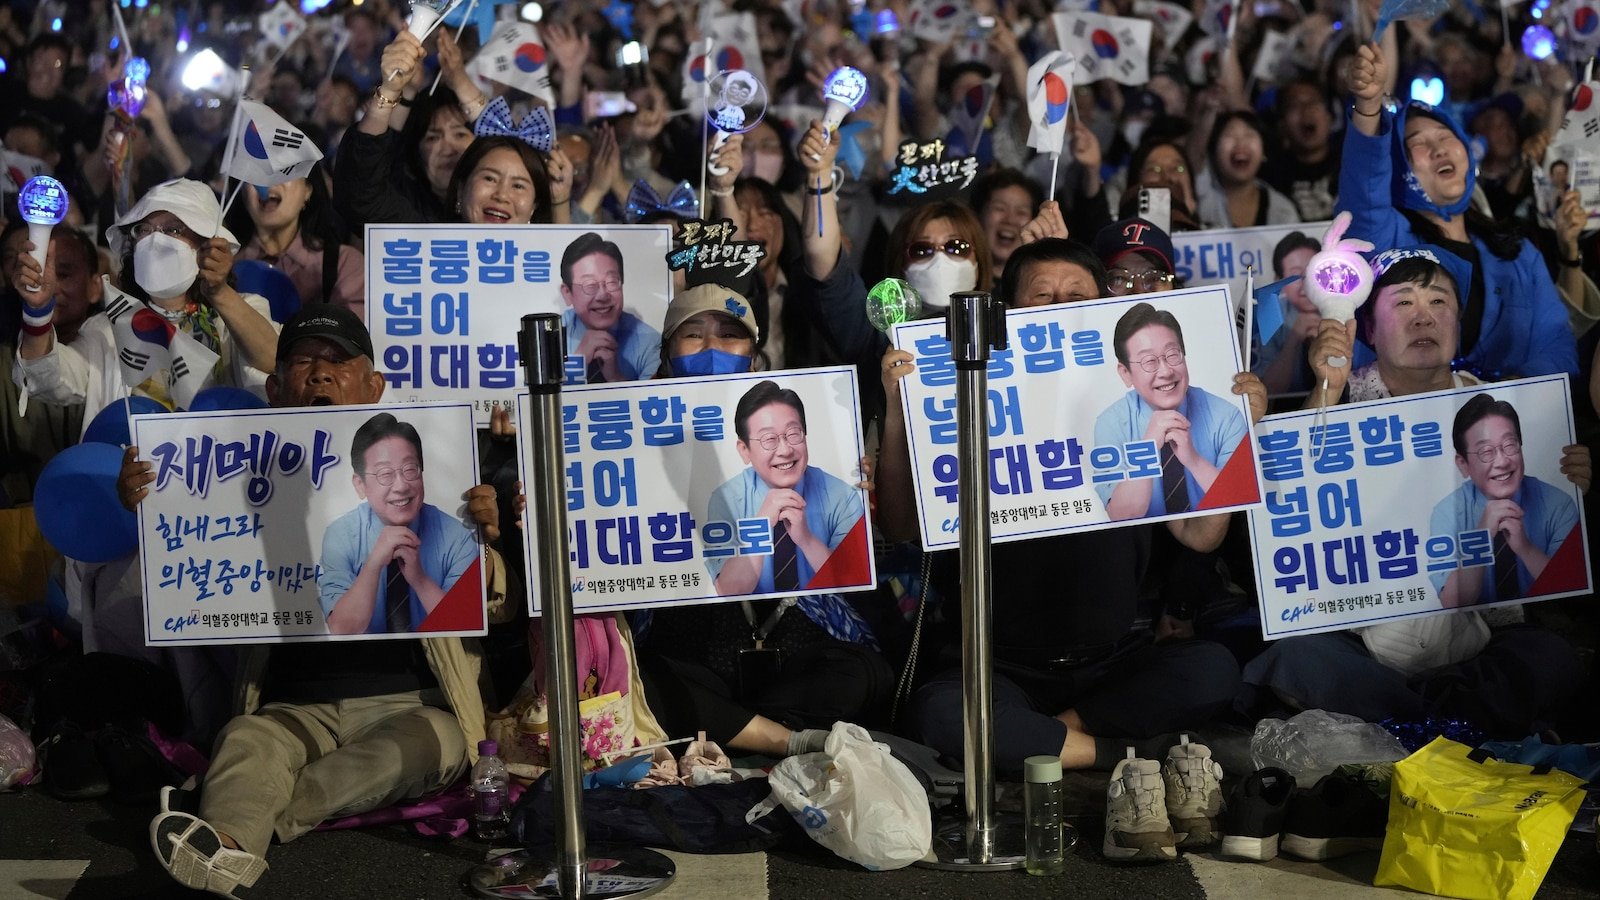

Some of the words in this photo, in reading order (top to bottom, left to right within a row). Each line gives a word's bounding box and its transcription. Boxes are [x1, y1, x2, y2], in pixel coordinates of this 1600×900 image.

[1122, 223, 1151, 246] T
[382, 238, 552, 284] 훌륭함을
[383, 292, 469, 337] 넘어
[383, 343, 587, 389] 위대함로
[1258, 414, 1443, 482] 훌륭함을
[990, 504, 1048, 525] 혈중앙대학교
[1051, 501, 1070, 517] 동문
[1073, 498, 1092, 514] 일동
[1265, 478, 1363, 538] 넘어
[587, 576, 655, 594] 의혈중앙대학교
[659, 574, 678, 589] 동문
[681, 572, 700, 587] 일동
[1273, 528, 1495, 595] 위대함으로
[202, 612, 269, 628] 의혈중앙대학교
[272, 611, 292, 626] 동문
[294, 610, 314, 625] 일동
[1318, 593, 1384, 614] 의혈중앙대학교
[1386, 589, 1405, 605] 동문
[1407, 587, 1426, 602] 일동
